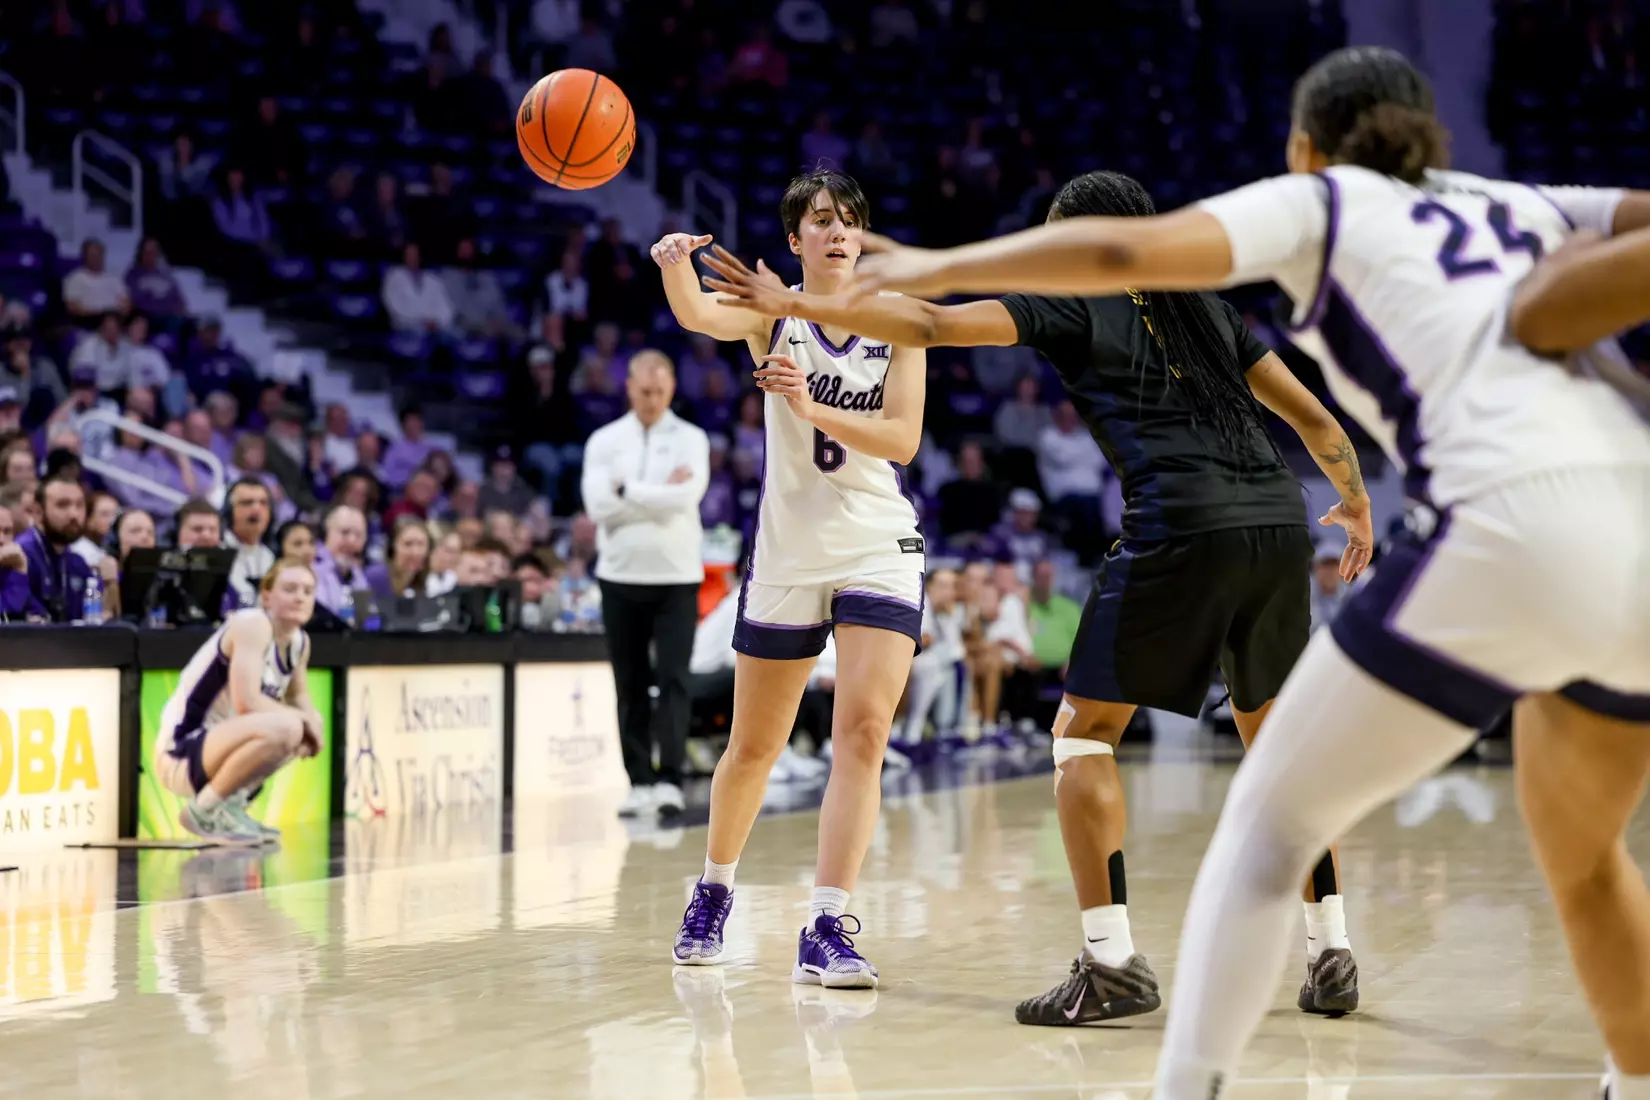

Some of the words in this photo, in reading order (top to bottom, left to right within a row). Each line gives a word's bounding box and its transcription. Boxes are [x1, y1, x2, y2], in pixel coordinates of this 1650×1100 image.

[864, 345, 888, 359] XII
[806, 371, 884, 411] ildcats
[813, 426, 847, 473] 6
[43, 801, 96, 830] EATS
